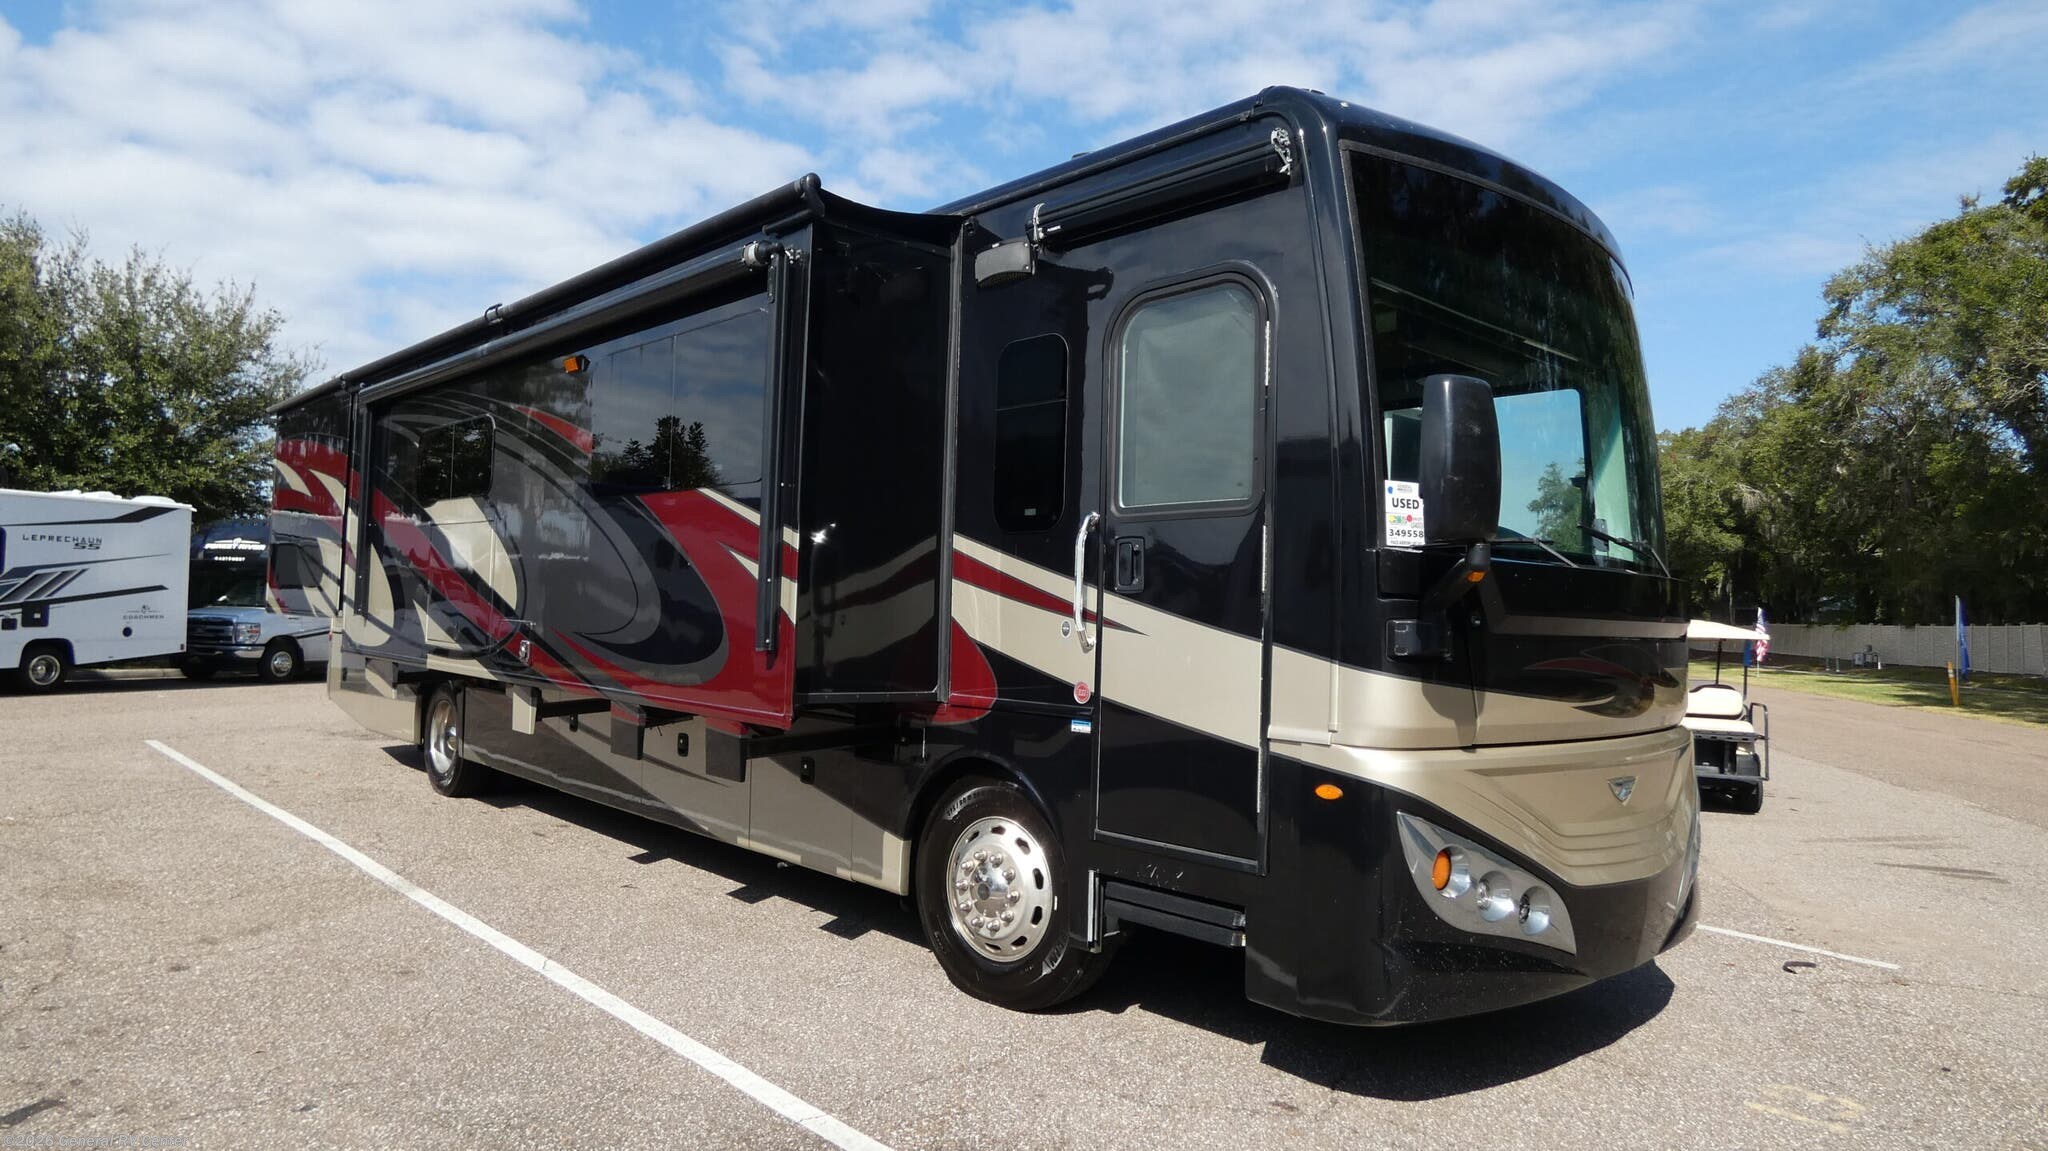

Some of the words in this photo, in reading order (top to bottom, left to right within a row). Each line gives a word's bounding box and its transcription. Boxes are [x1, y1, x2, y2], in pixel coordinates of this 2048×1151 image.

[1392, 497, 1420, 510] USED
[1388, 528, 1424, 538] 349558
[22, 534, 103, 544] LEPRECHAUN
